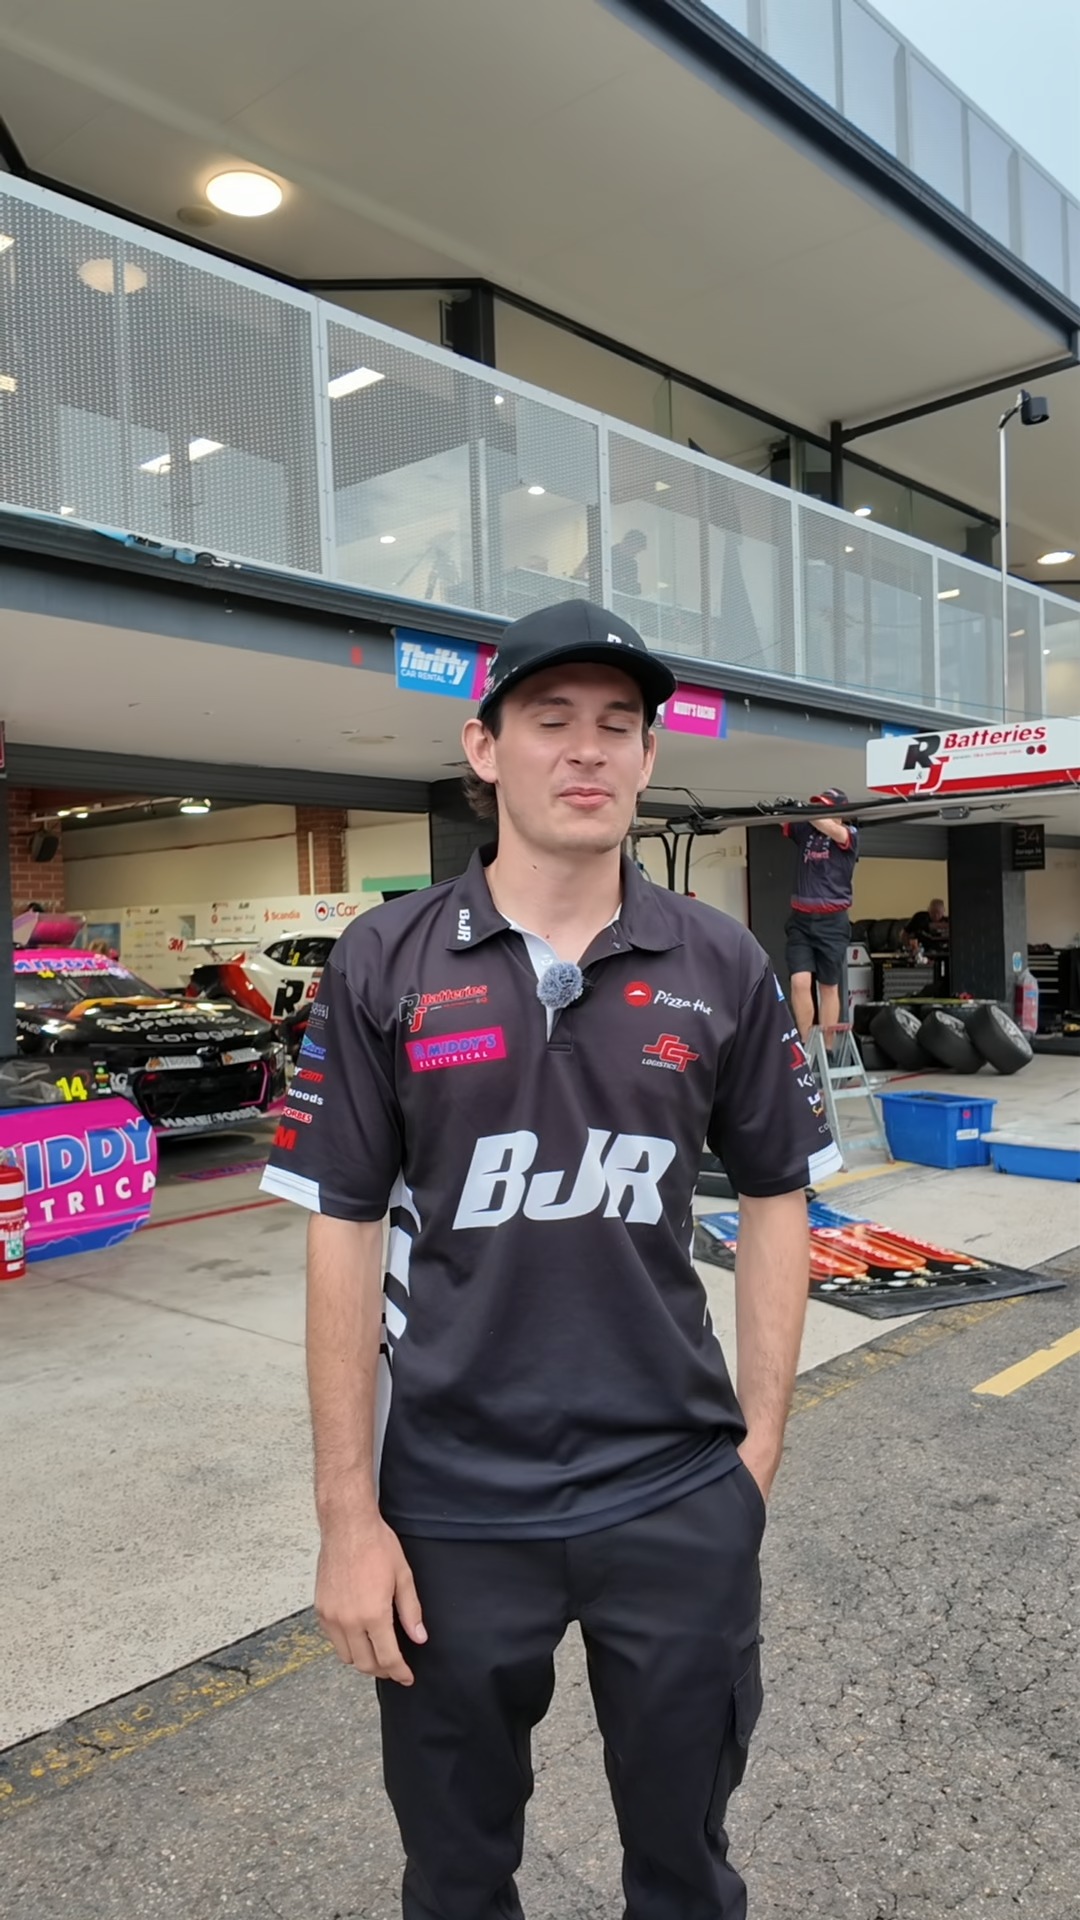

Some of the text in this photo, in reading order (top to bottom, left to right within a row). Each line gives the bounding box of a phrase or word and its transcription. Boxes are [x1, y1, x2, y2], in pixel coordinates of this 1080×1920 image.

[401, 642, 470, 685] Thrifty
[401, 668, 447, 683] CAR RENTAL
[943, 725, 1047, 749] Batteries
[1016, 828, 1040, 846] 34
[457, 909, 471, 941] BJR
[168, 938, 184, 951] 3M
[420, 985, 488, 1006] Batteries
[653, 990, 713, 1015] Pizza Hut
[427, 1034, 496, 1058] MIDDY'S
[420, 1051, 488, 1068] ELECTRICAL
[641, 1058, 677, 1070] LOGISTICS
[56, 1076, 88, 1101] 14
[0, 1116, 153, 1194] IDDY
[452, 1127, 676, 1230] BJR
[24, 1170, 156, 1229] TRICA
